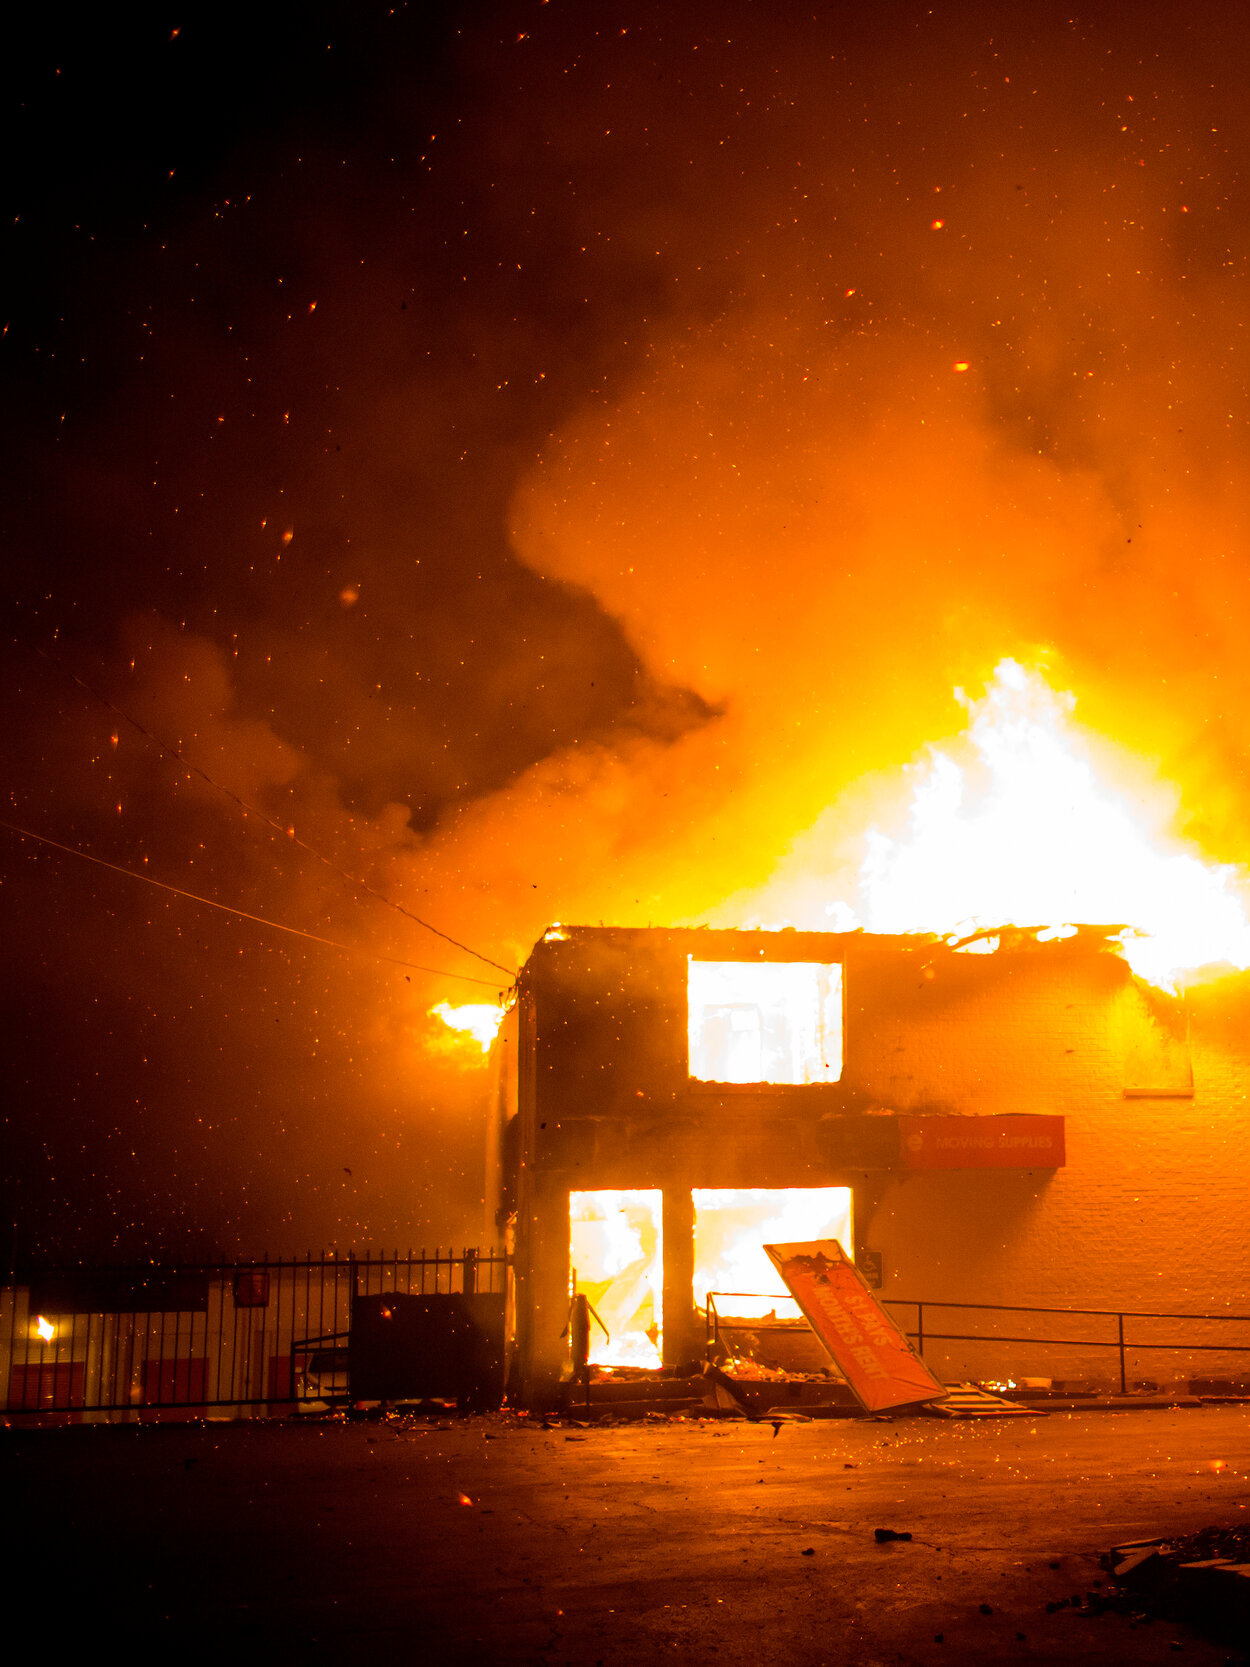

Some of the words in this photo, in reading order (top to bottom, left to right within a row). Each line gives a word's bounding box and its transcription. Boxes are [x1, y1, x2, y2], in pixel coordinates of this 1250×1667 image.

[936, 1136, 994, 1149] MOVING
[998, 1136, 1053, 1149] SUPPLIES
[844, 1295, 869, 1310] $1
[856, 1313, 893, 1346] PAYS
[849, 1345, 889, 1379] RENT
